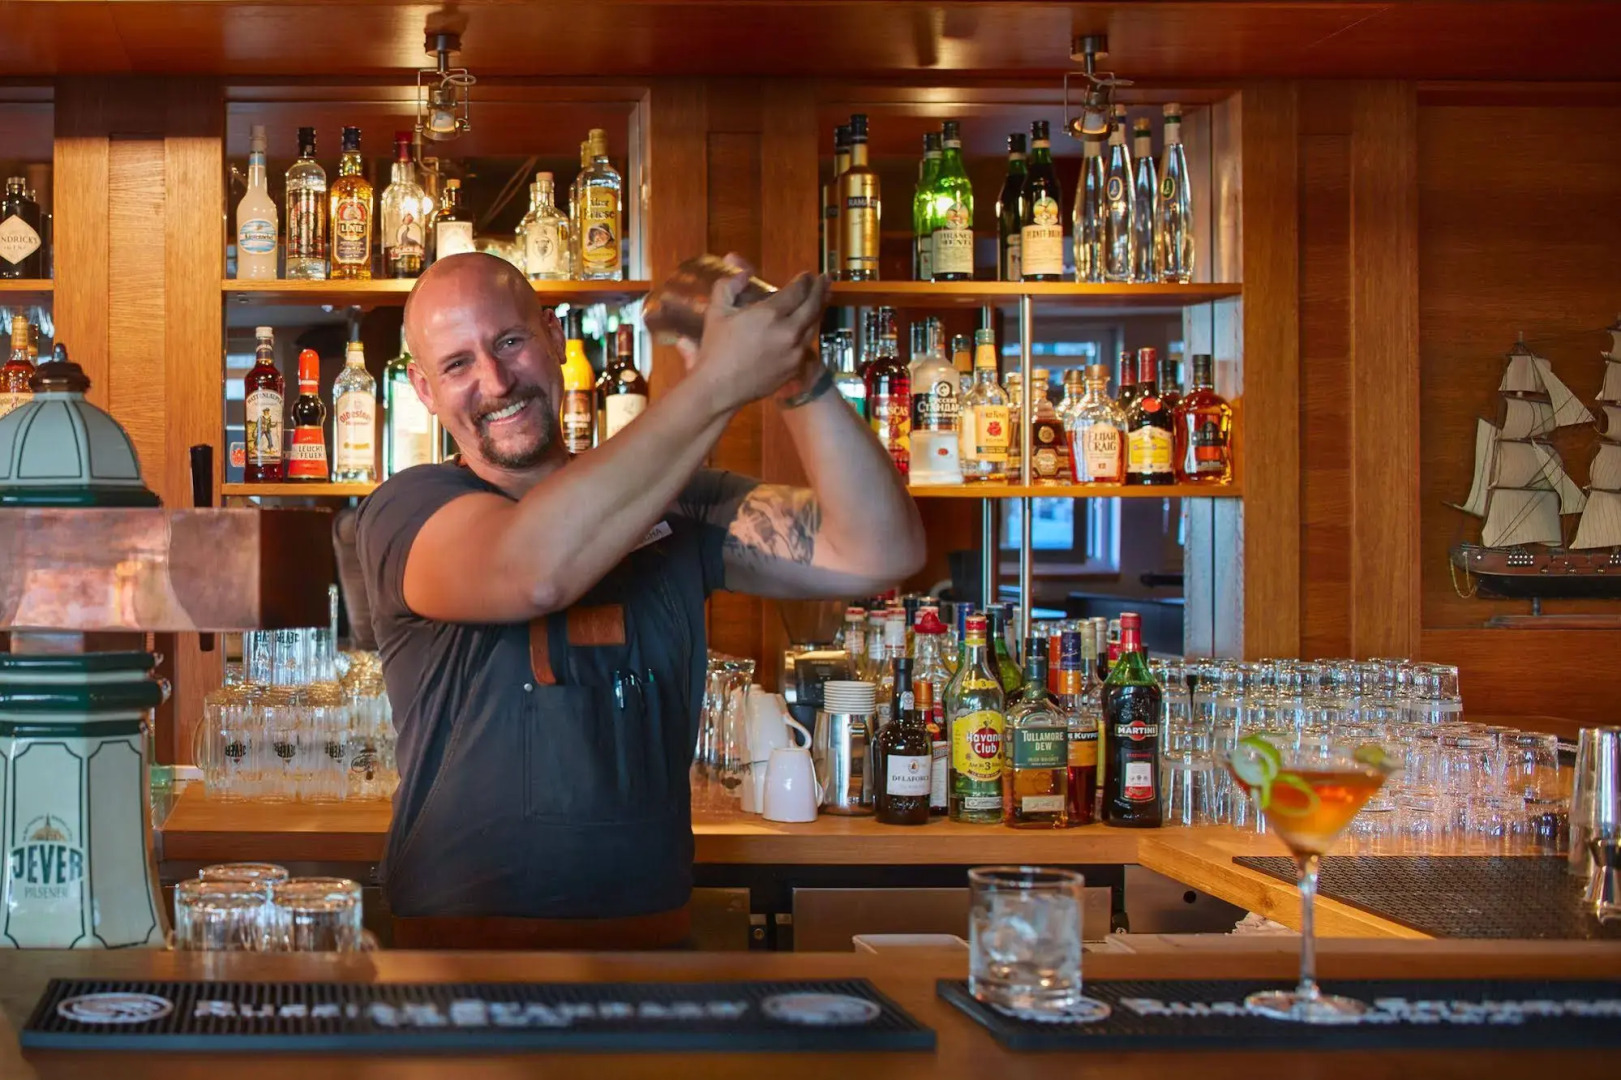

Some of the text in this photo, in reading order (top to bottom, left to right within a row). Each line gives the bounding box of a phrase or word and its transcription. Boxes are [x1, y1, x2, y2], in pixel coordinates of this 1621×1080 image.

[0, 235, 38, 244] NDRICK'S
[1118, 726, 1155, 734] MARTINI
[1022, 730, 1063, 742] TULLAMORE
[974, 743, 997, 754] Club
[1035, 742, 1052, 751] DEW
[12, 844, 83, 884] JEVER
